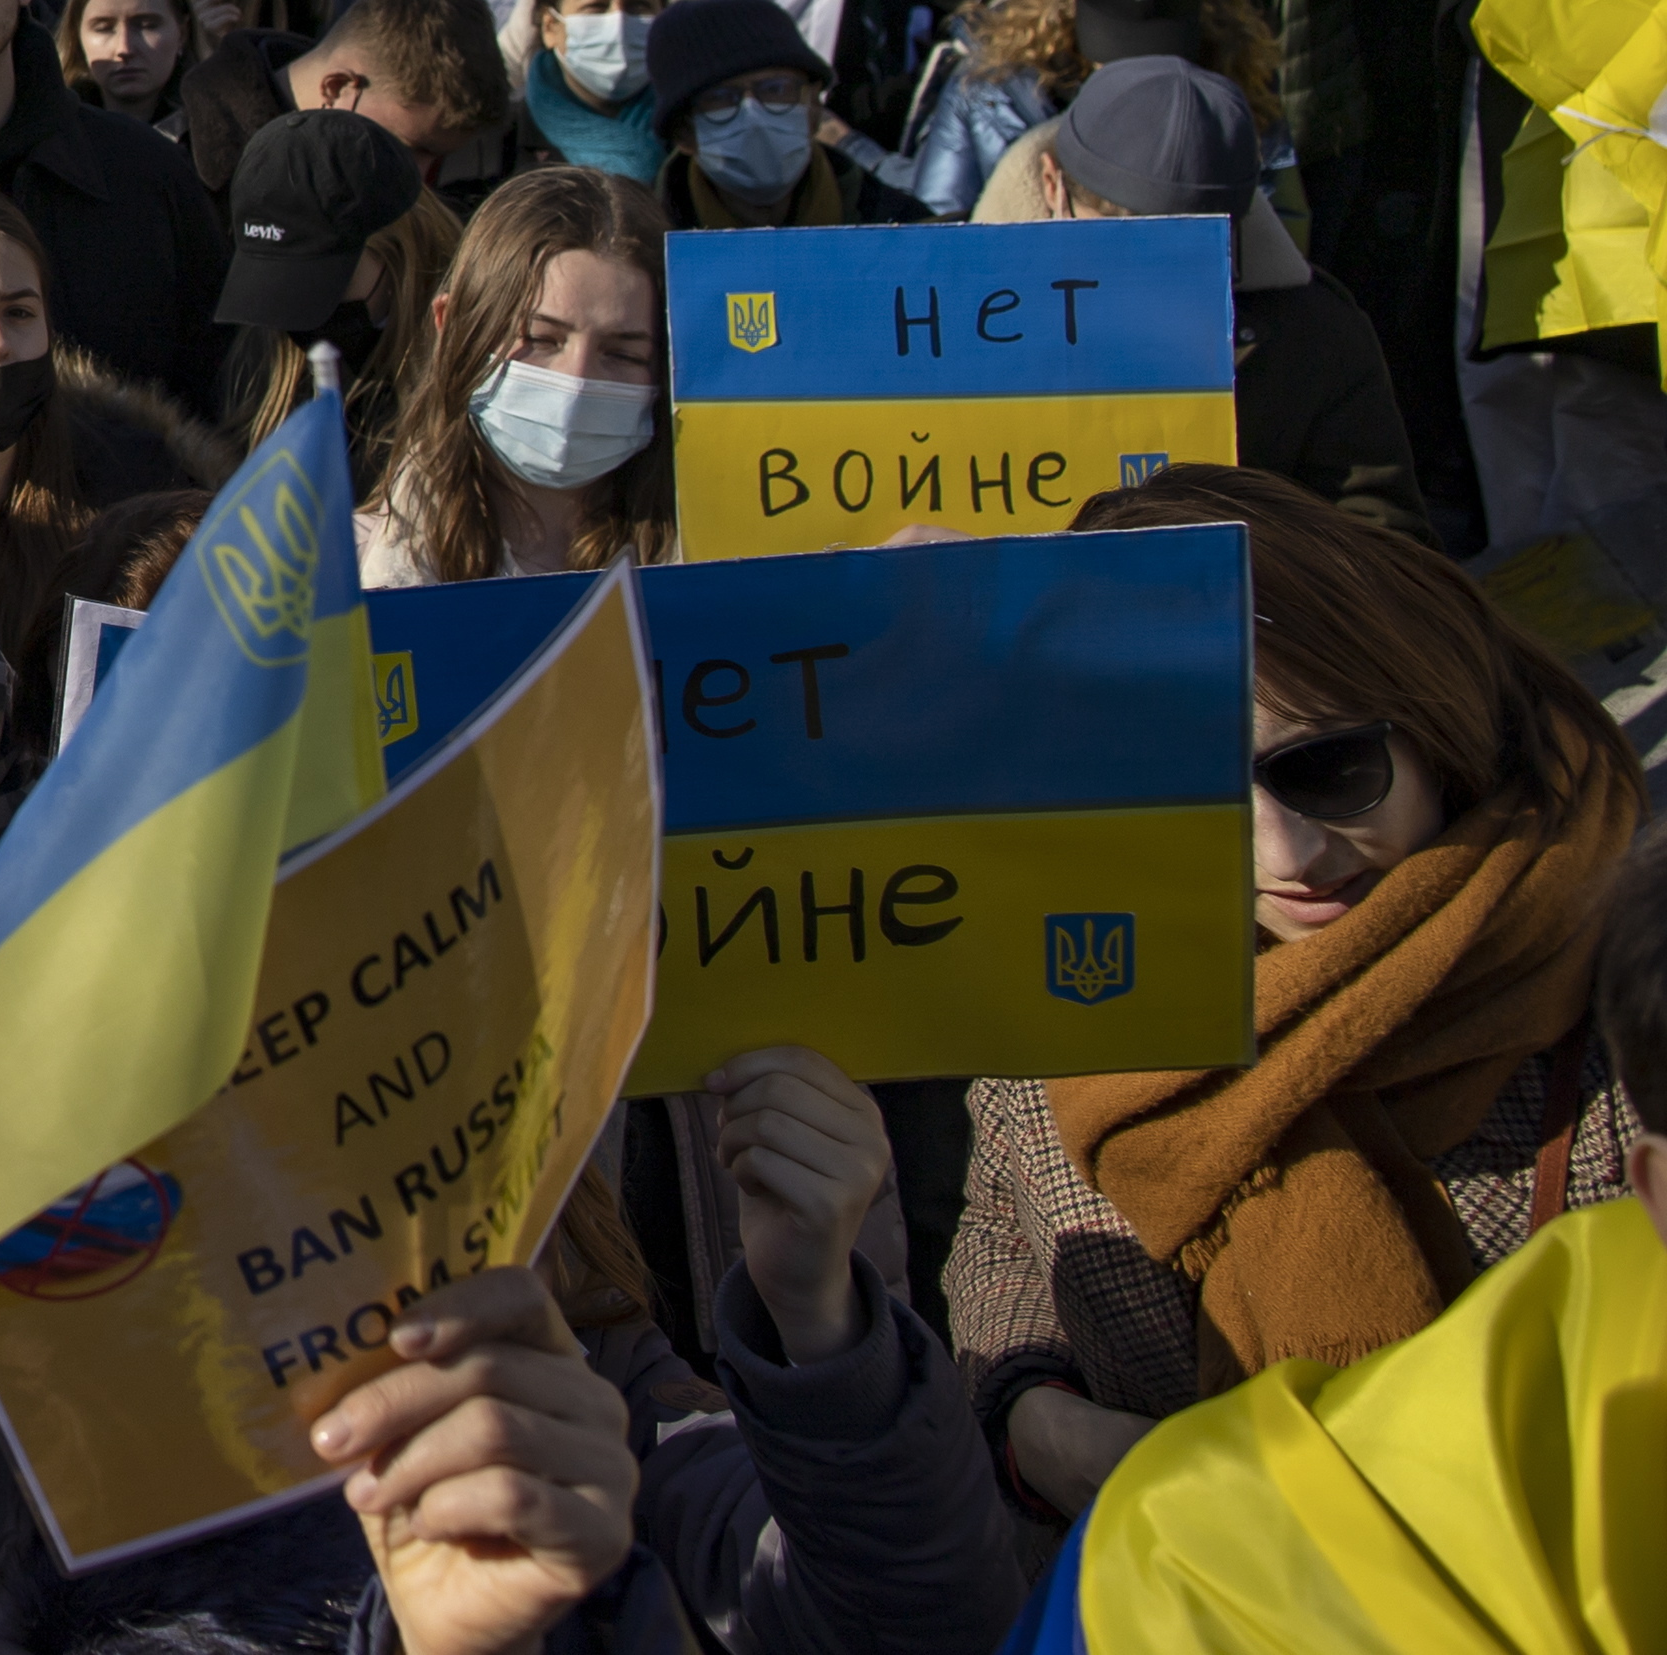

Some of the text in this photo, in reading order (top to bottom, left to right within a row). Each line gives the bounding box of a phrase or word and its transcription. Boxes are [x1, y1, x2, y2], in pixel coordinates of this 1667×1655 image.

[657, 641, 851, 743] ет
[348, 857, 506, 1014] CALM
[657, 845, 965, 970] йне
[331, 1029, 455, 1147] AND
[234, 1031, 556, 1298] BAN RUSSIA
